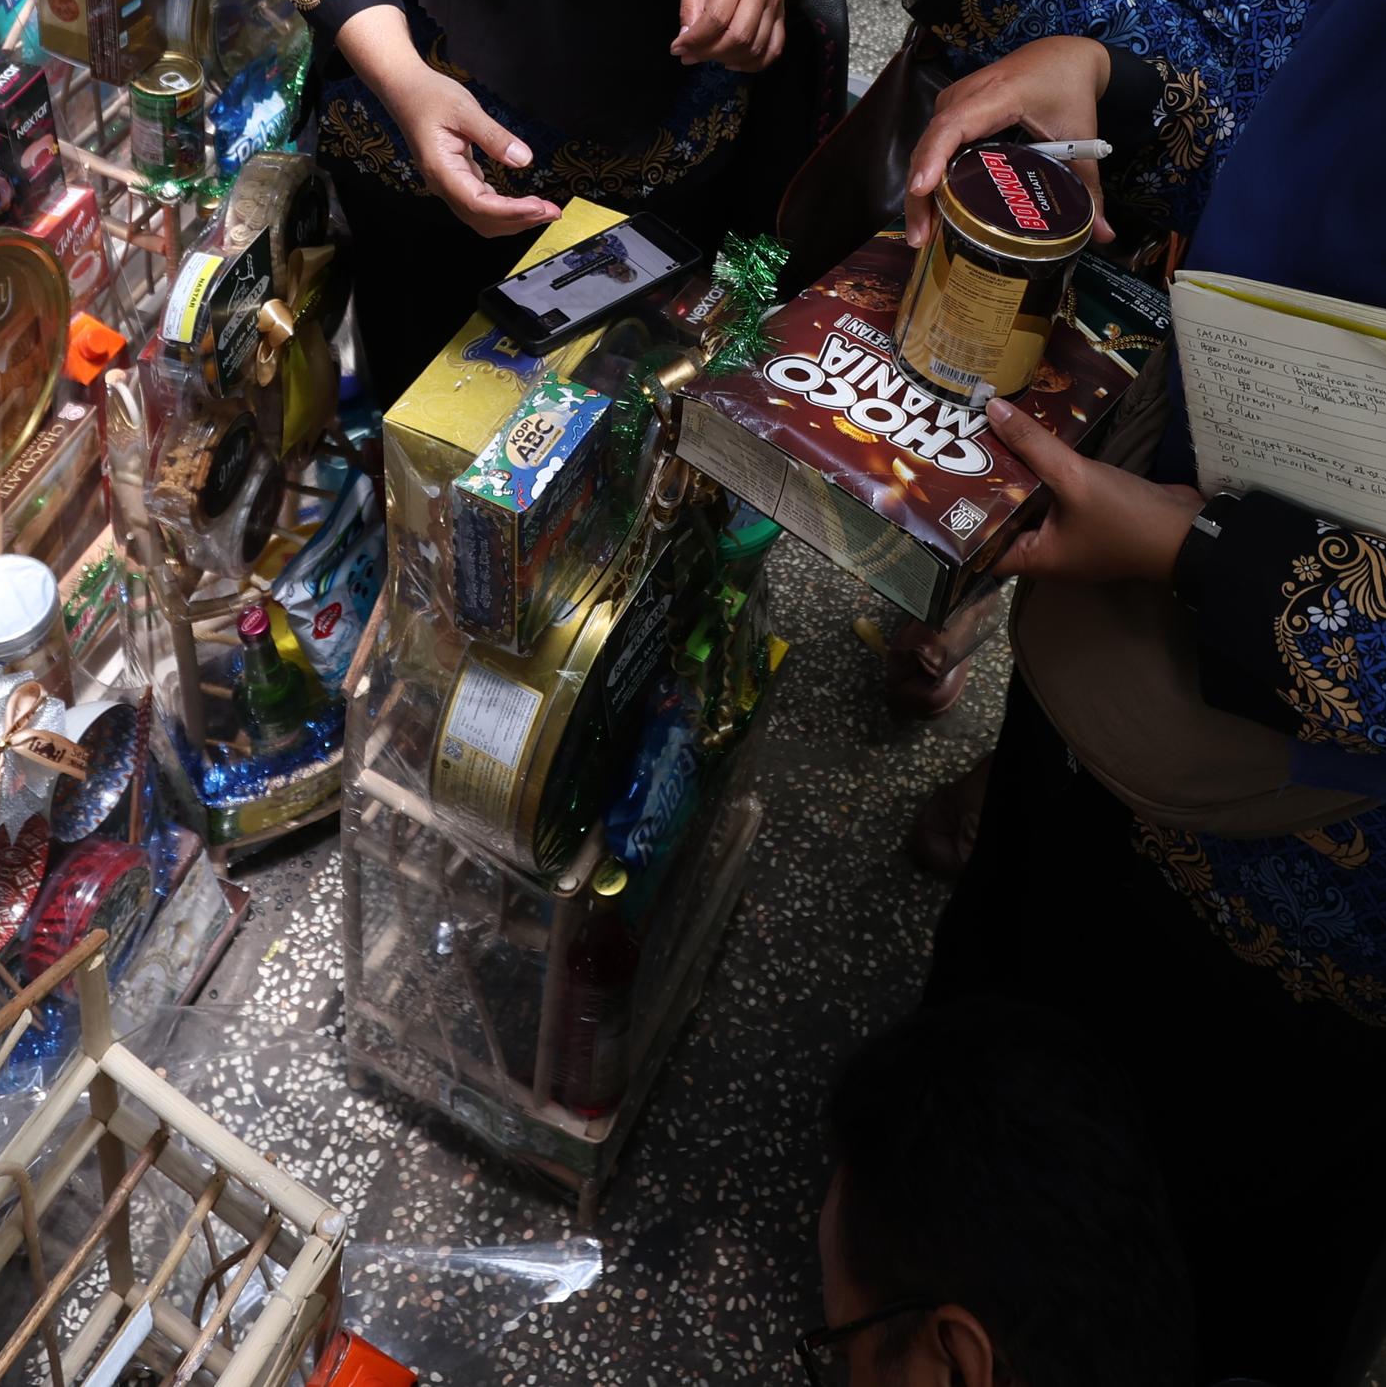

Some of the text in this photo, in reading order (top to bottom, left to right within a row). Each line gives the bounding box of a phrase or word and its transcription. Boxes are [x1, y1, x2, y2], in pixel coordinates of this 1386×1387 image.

[978, 150, 1050, 231] BONKOPI
[1026, 170, 1051, 212] CAFFE LATTE
[189, 276, 206, 309] NASTAR
[1197, 328, 1247, 347] SASARAN
[818, 332, 990, 440] MANIA
[1219, 386, 1275, 411] Hypermart
[509, 418, 534, 446] KOPI
[763, 354, 994, 477] CHOCO
[1226, 403, 1262, 421] Golden
[0, 423, 66, 500] CHOCOLATE
[516, 418, 555, 463] ABC
